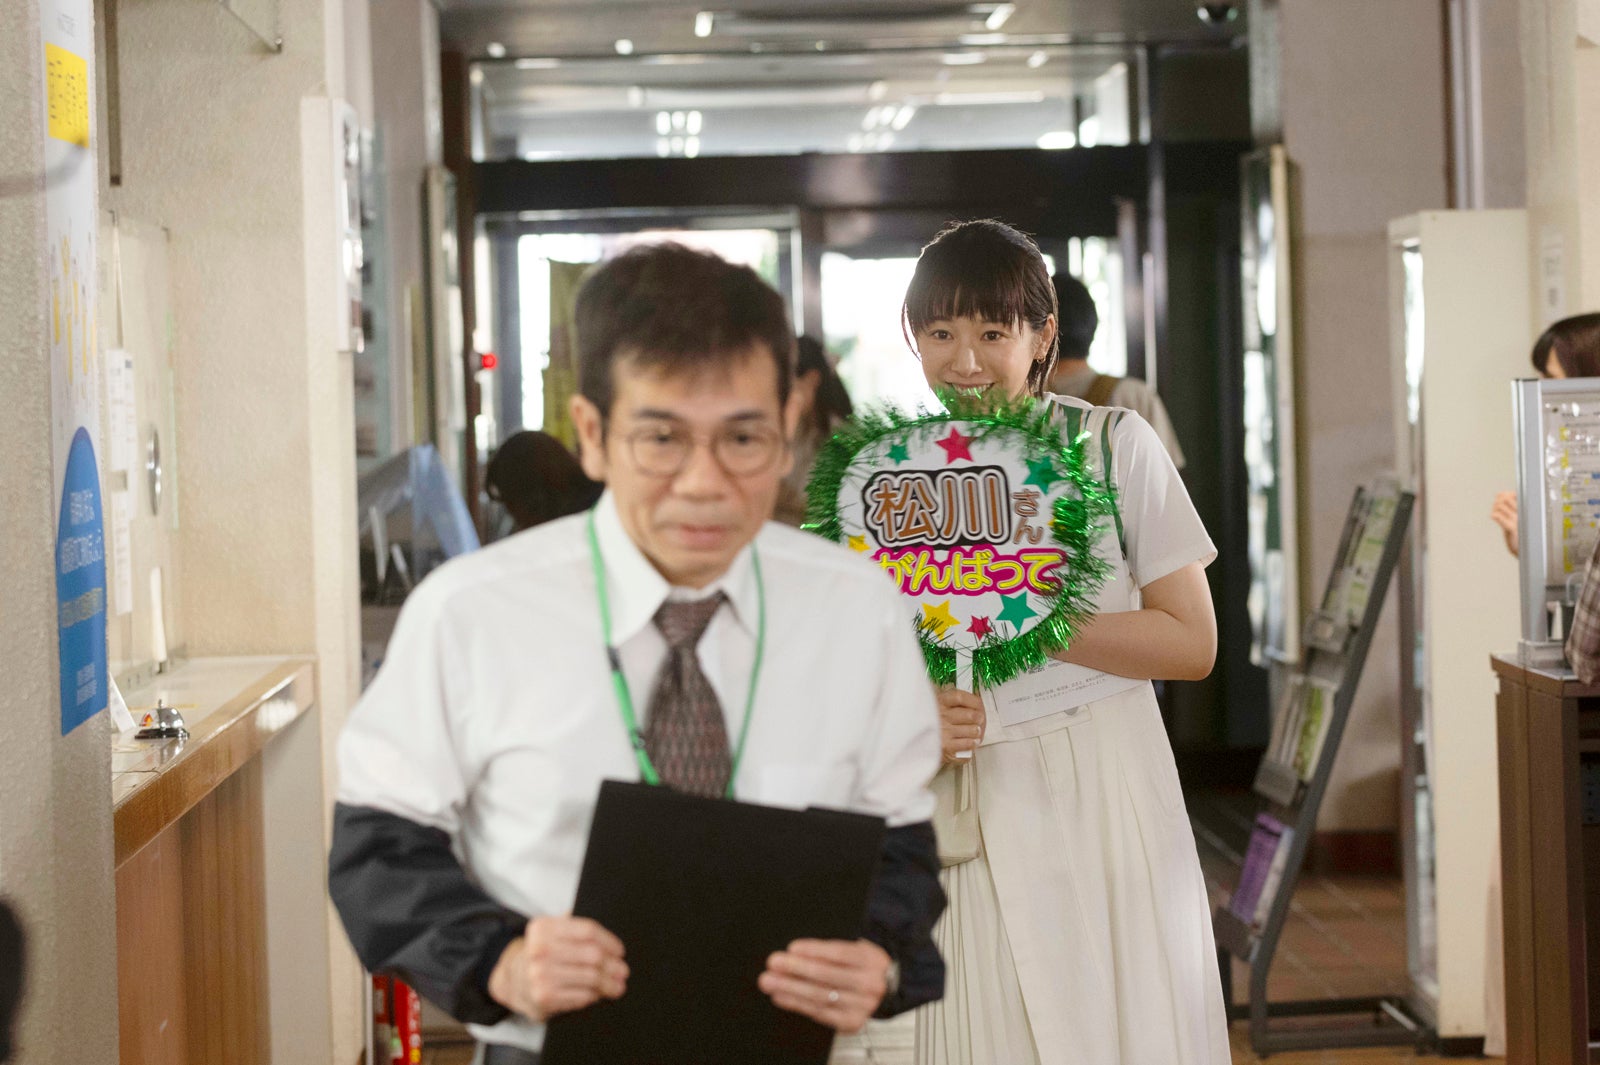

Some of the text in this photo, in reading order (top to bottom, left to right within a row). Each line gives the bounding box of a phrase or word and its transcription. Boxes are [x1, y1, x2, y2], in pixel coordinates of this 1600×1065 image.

[880, 549, 1064, 593] がんばって
